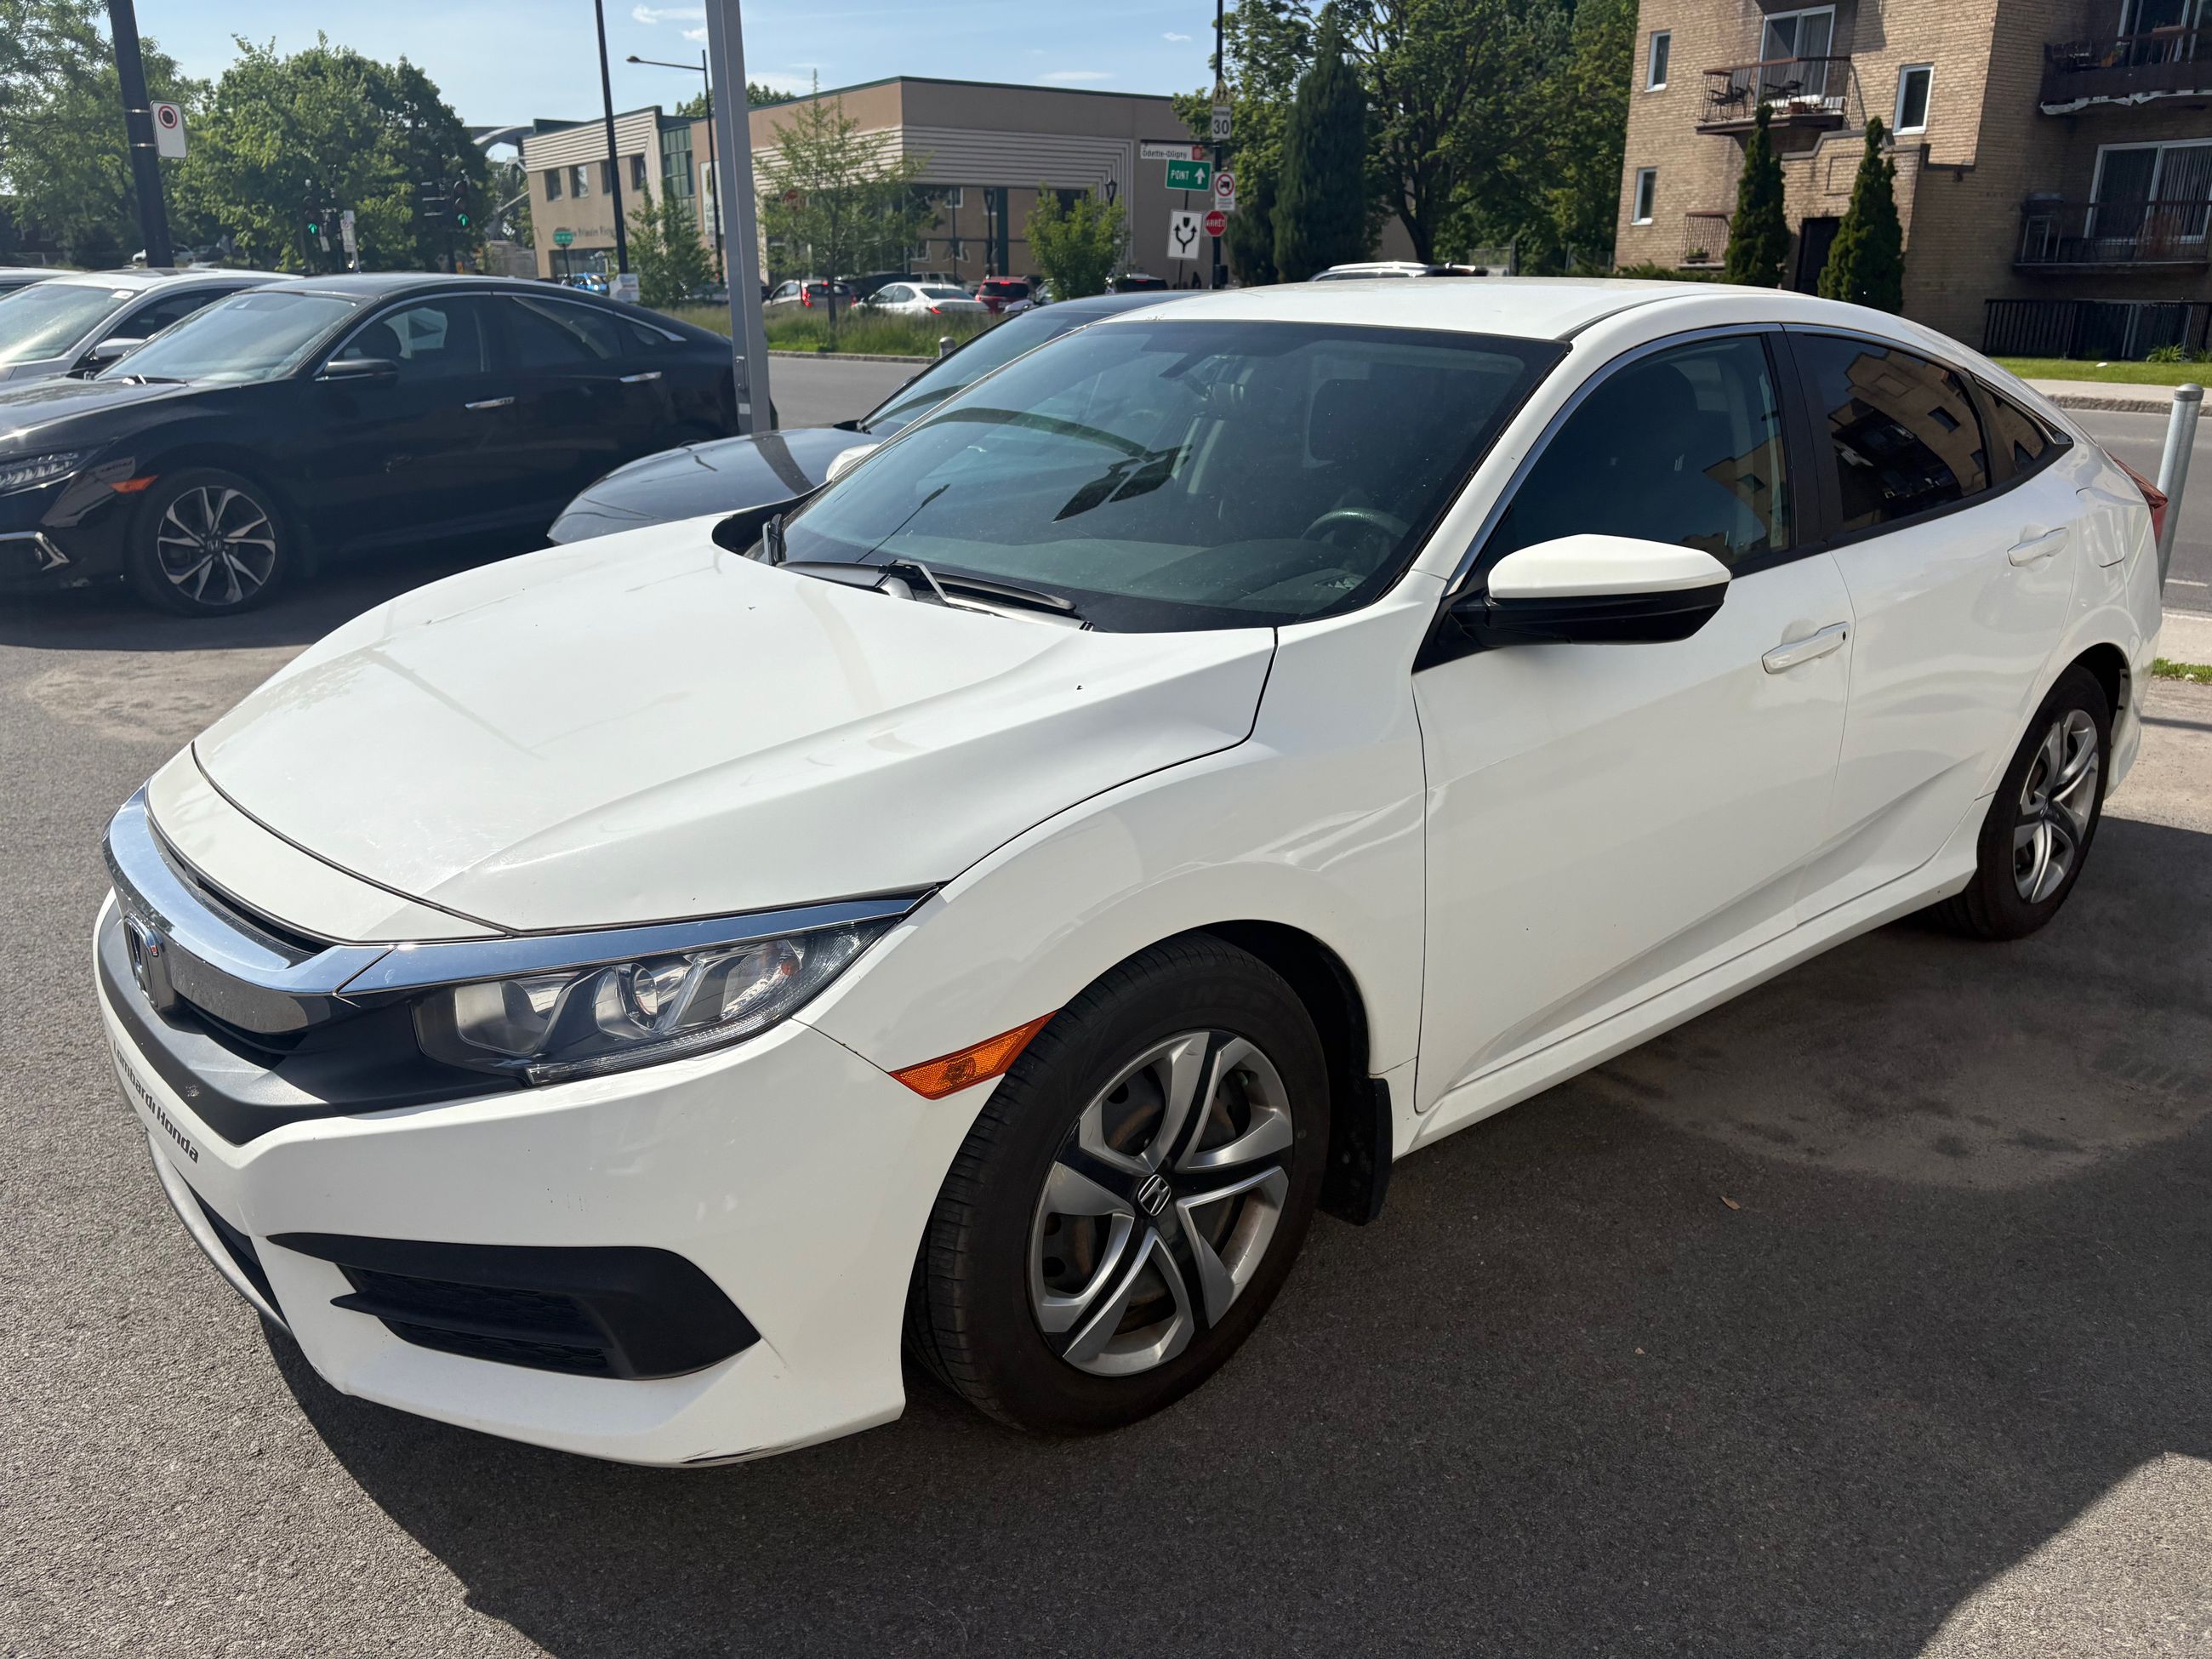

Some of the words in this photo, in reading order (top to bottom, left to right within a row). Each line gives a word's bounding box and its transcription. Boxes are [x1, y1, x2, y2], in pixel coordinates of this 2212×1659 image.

[1213, 119, 1229, 134] 30
[1170, 169, 1189, 180] PONT
[113, 1039, 156, 1114] Lombardi
[157, 1105, 199, 1164] Honda
